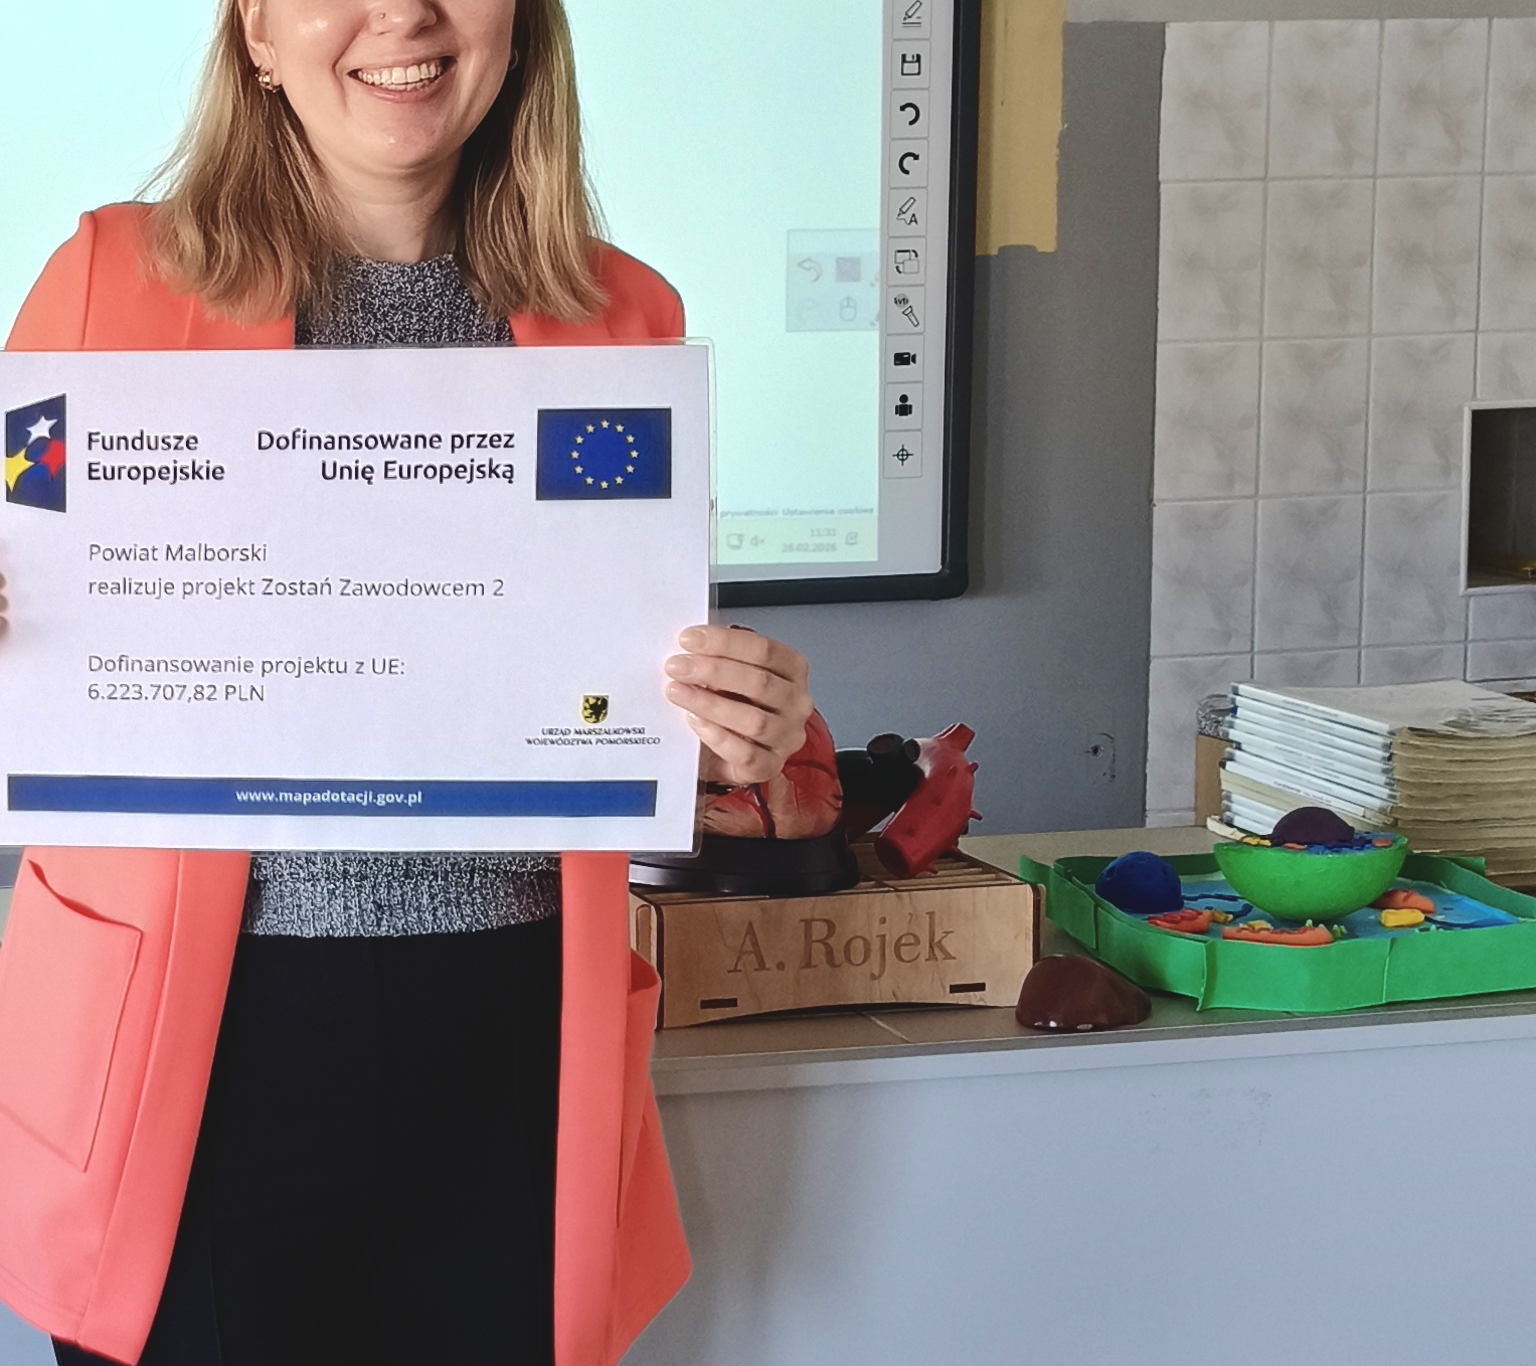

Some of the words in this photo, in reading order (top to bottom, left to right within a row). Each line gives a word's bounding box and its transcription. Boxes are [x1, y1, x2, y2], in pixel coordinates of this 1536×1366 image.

[88, 430, 199, 451] Fundusze
[257, 428, 443, 451] Dofinansowane
[450, 433, 515, 454] przez
[87, 459, 226, 485] Europejskie
[321, 460, 375, 485] Unię
[384, 458, 515, 485] Europejską
[89, 543, 159, 562] Powiat
[165, 542, 267, 562] Malborski
[88, 576, 175, 600] realizuje
[182, 576, 256, 600] projekt
[261, 576, 332, 597] Zostań
[339, 577, 485, 597] Zawodowcem
[492, 578, 504, 597] 2
[88, 655, 255, 675] Dofinansowanie
[261, 655, 348, 679] projektu
[354, 661, 365, 675] z
[371, 657, 405, 676] UE:
[88, 683, 218, 704] 6.223.707,82
[224, 684, 264, 702] PLN
[525, 736, 593, 746] WOJEWÓDZTWA
[235, 789, 423, 808] www.mapadotacji.gov.pl
[727, 920, 786, 975] A.
[798, 911, 957, 981] Rojek
